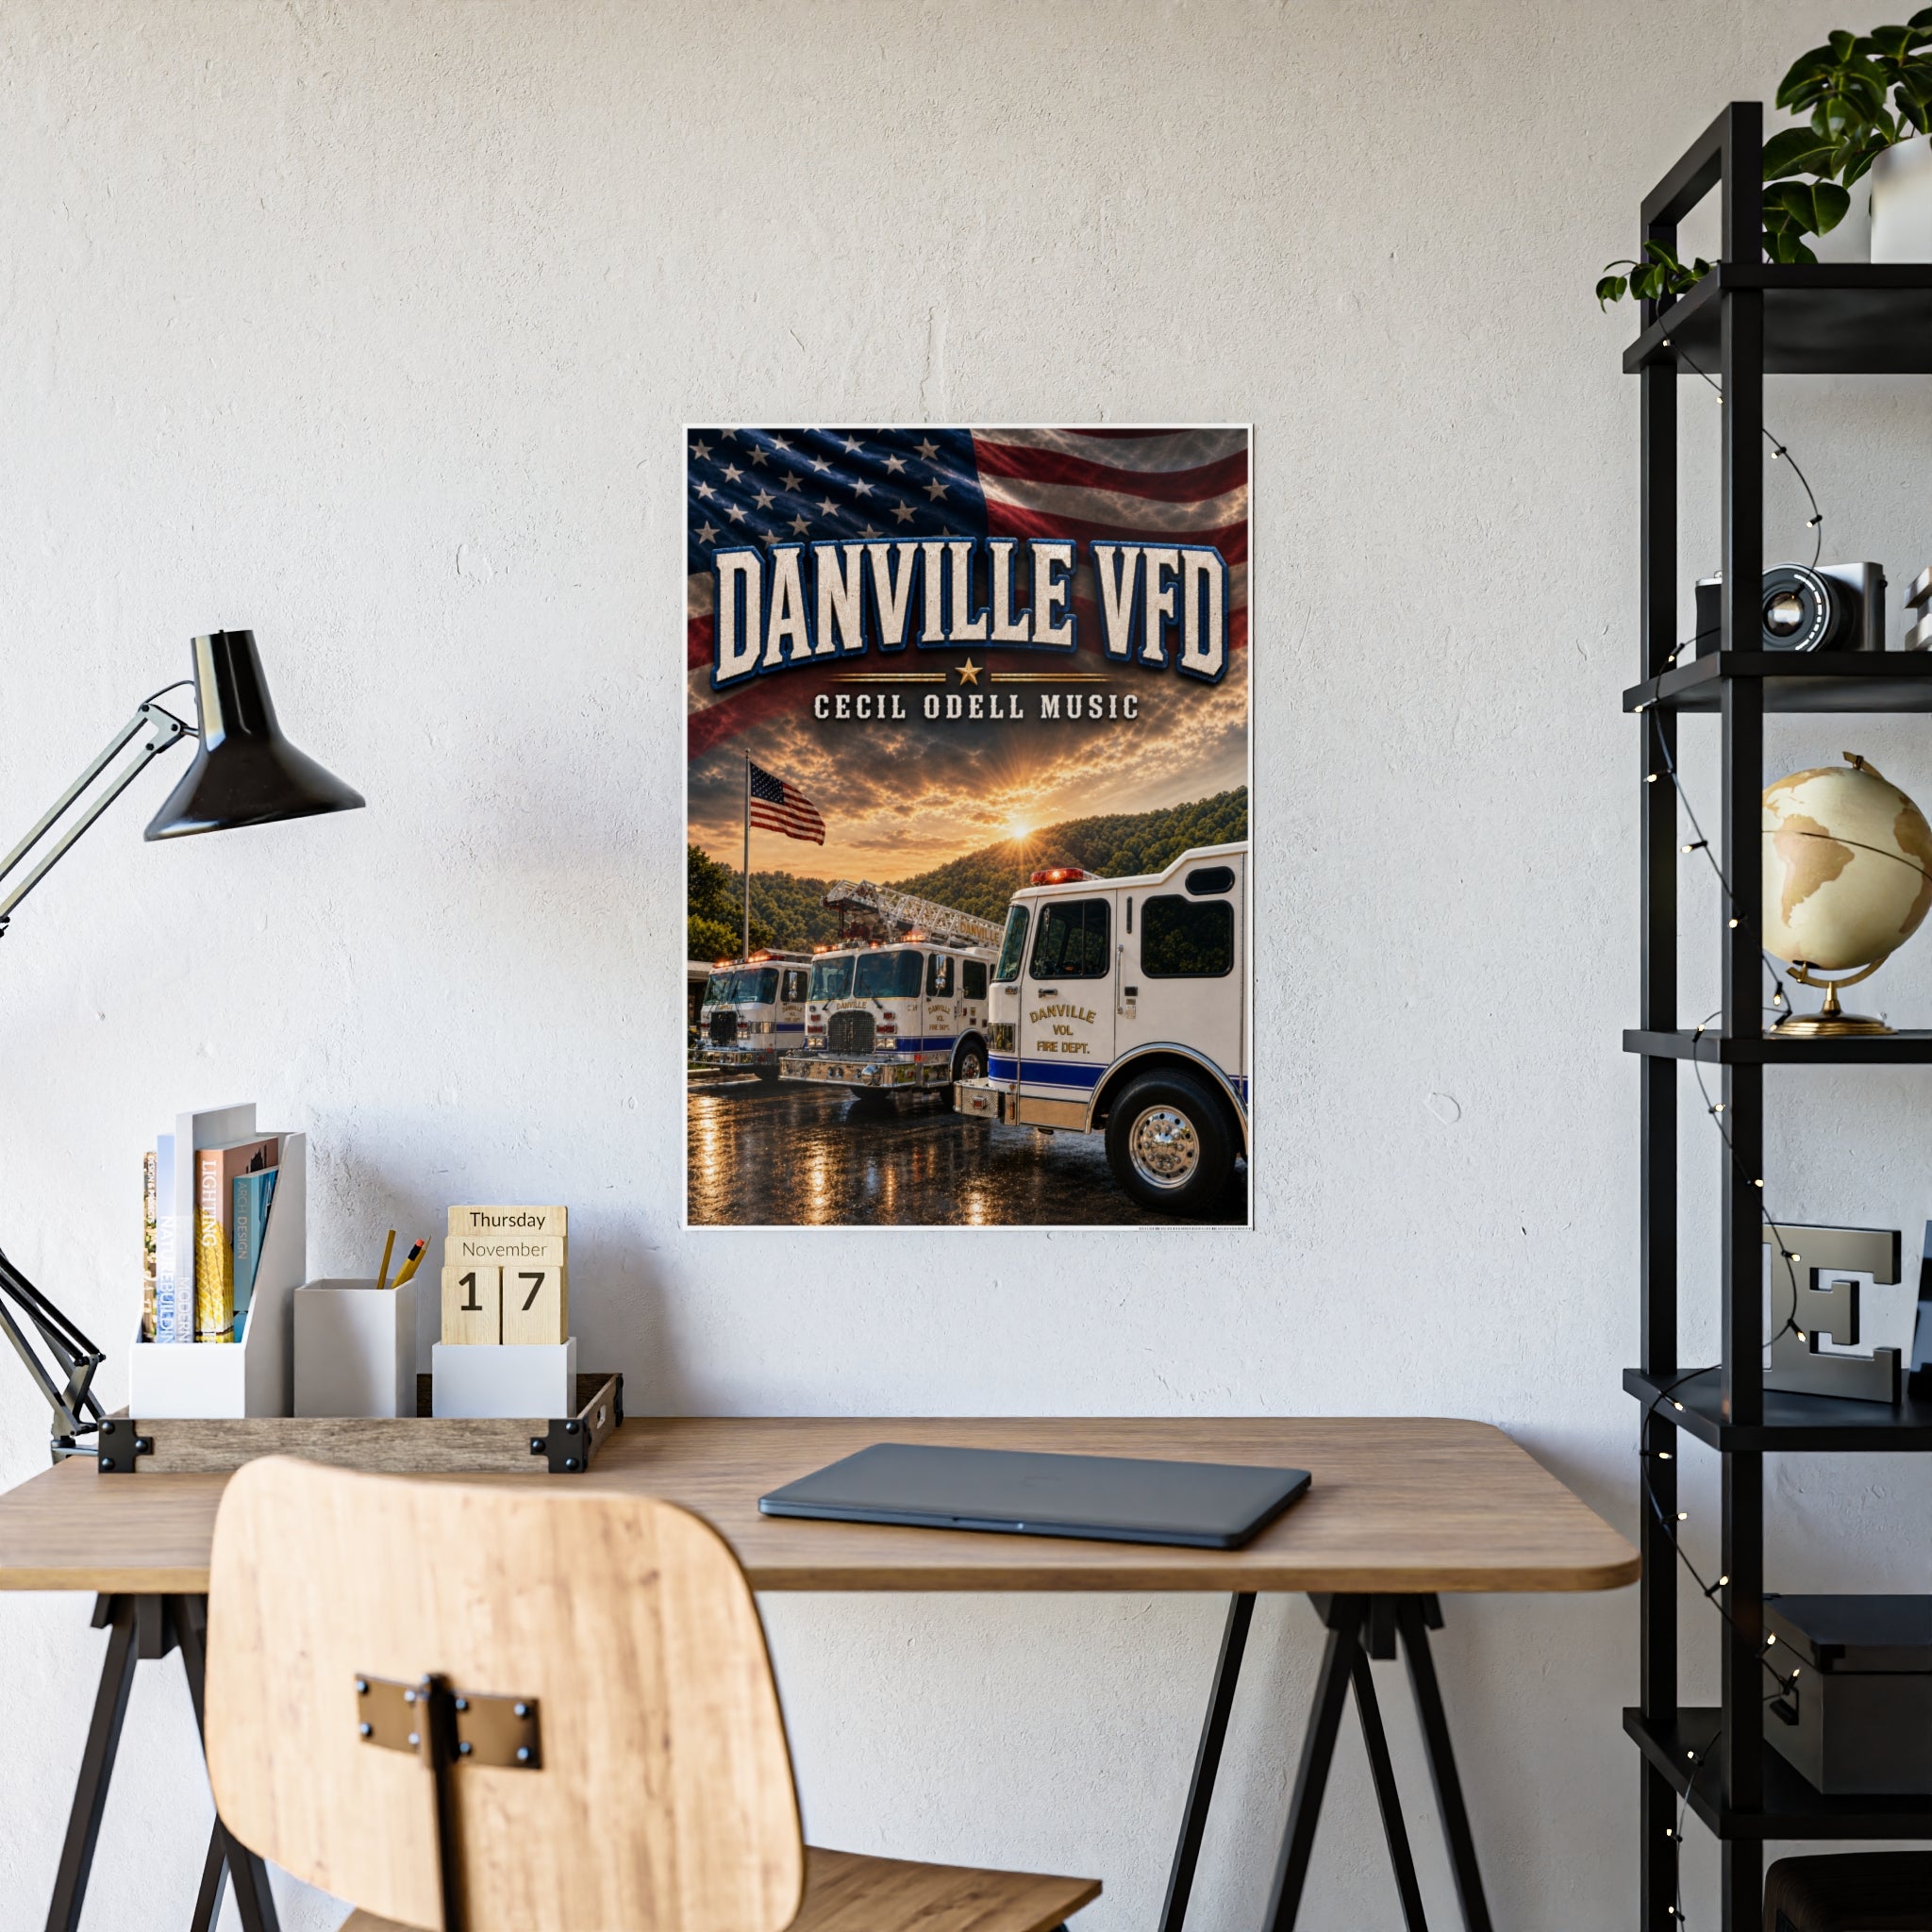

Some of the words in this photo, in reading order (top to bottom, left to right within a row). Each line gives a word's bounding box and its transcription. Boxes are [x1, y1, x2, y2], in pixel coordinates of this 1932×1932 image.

[713, 540, 1075, 687] DANVILLE
[1091, 541, 1226, 683] VFD
[813, 693, 908, 720] CECIL
[923, 693, 1024, 720] ODELL
[1040, 693, 1140, 720] MUSIC
[959, 920, 1000, 943] DANVILLE
[836, 1001, 867, 1010] DANVILLE
[1029, 1004, 1096, 1024] DANVILLE
[1052, 1024, 1074, 1036] VOL
[1037, 1041, 1058, 1052] FIRE
[1061, 1041, 1091, 1054] DEPT.
[147, 1155, 156, 1181] DESIGN
[202, 1160, 217, 1247] LIGHTING
[237, 1181, 248, 1213] ARCH
[470, 1212, 545, 1230] Thursday
[237, 1216, 248, 1260] DESIGN
[462, 1241, 547, 1257] November
[177, 1276, 192, 1341] MODERN
